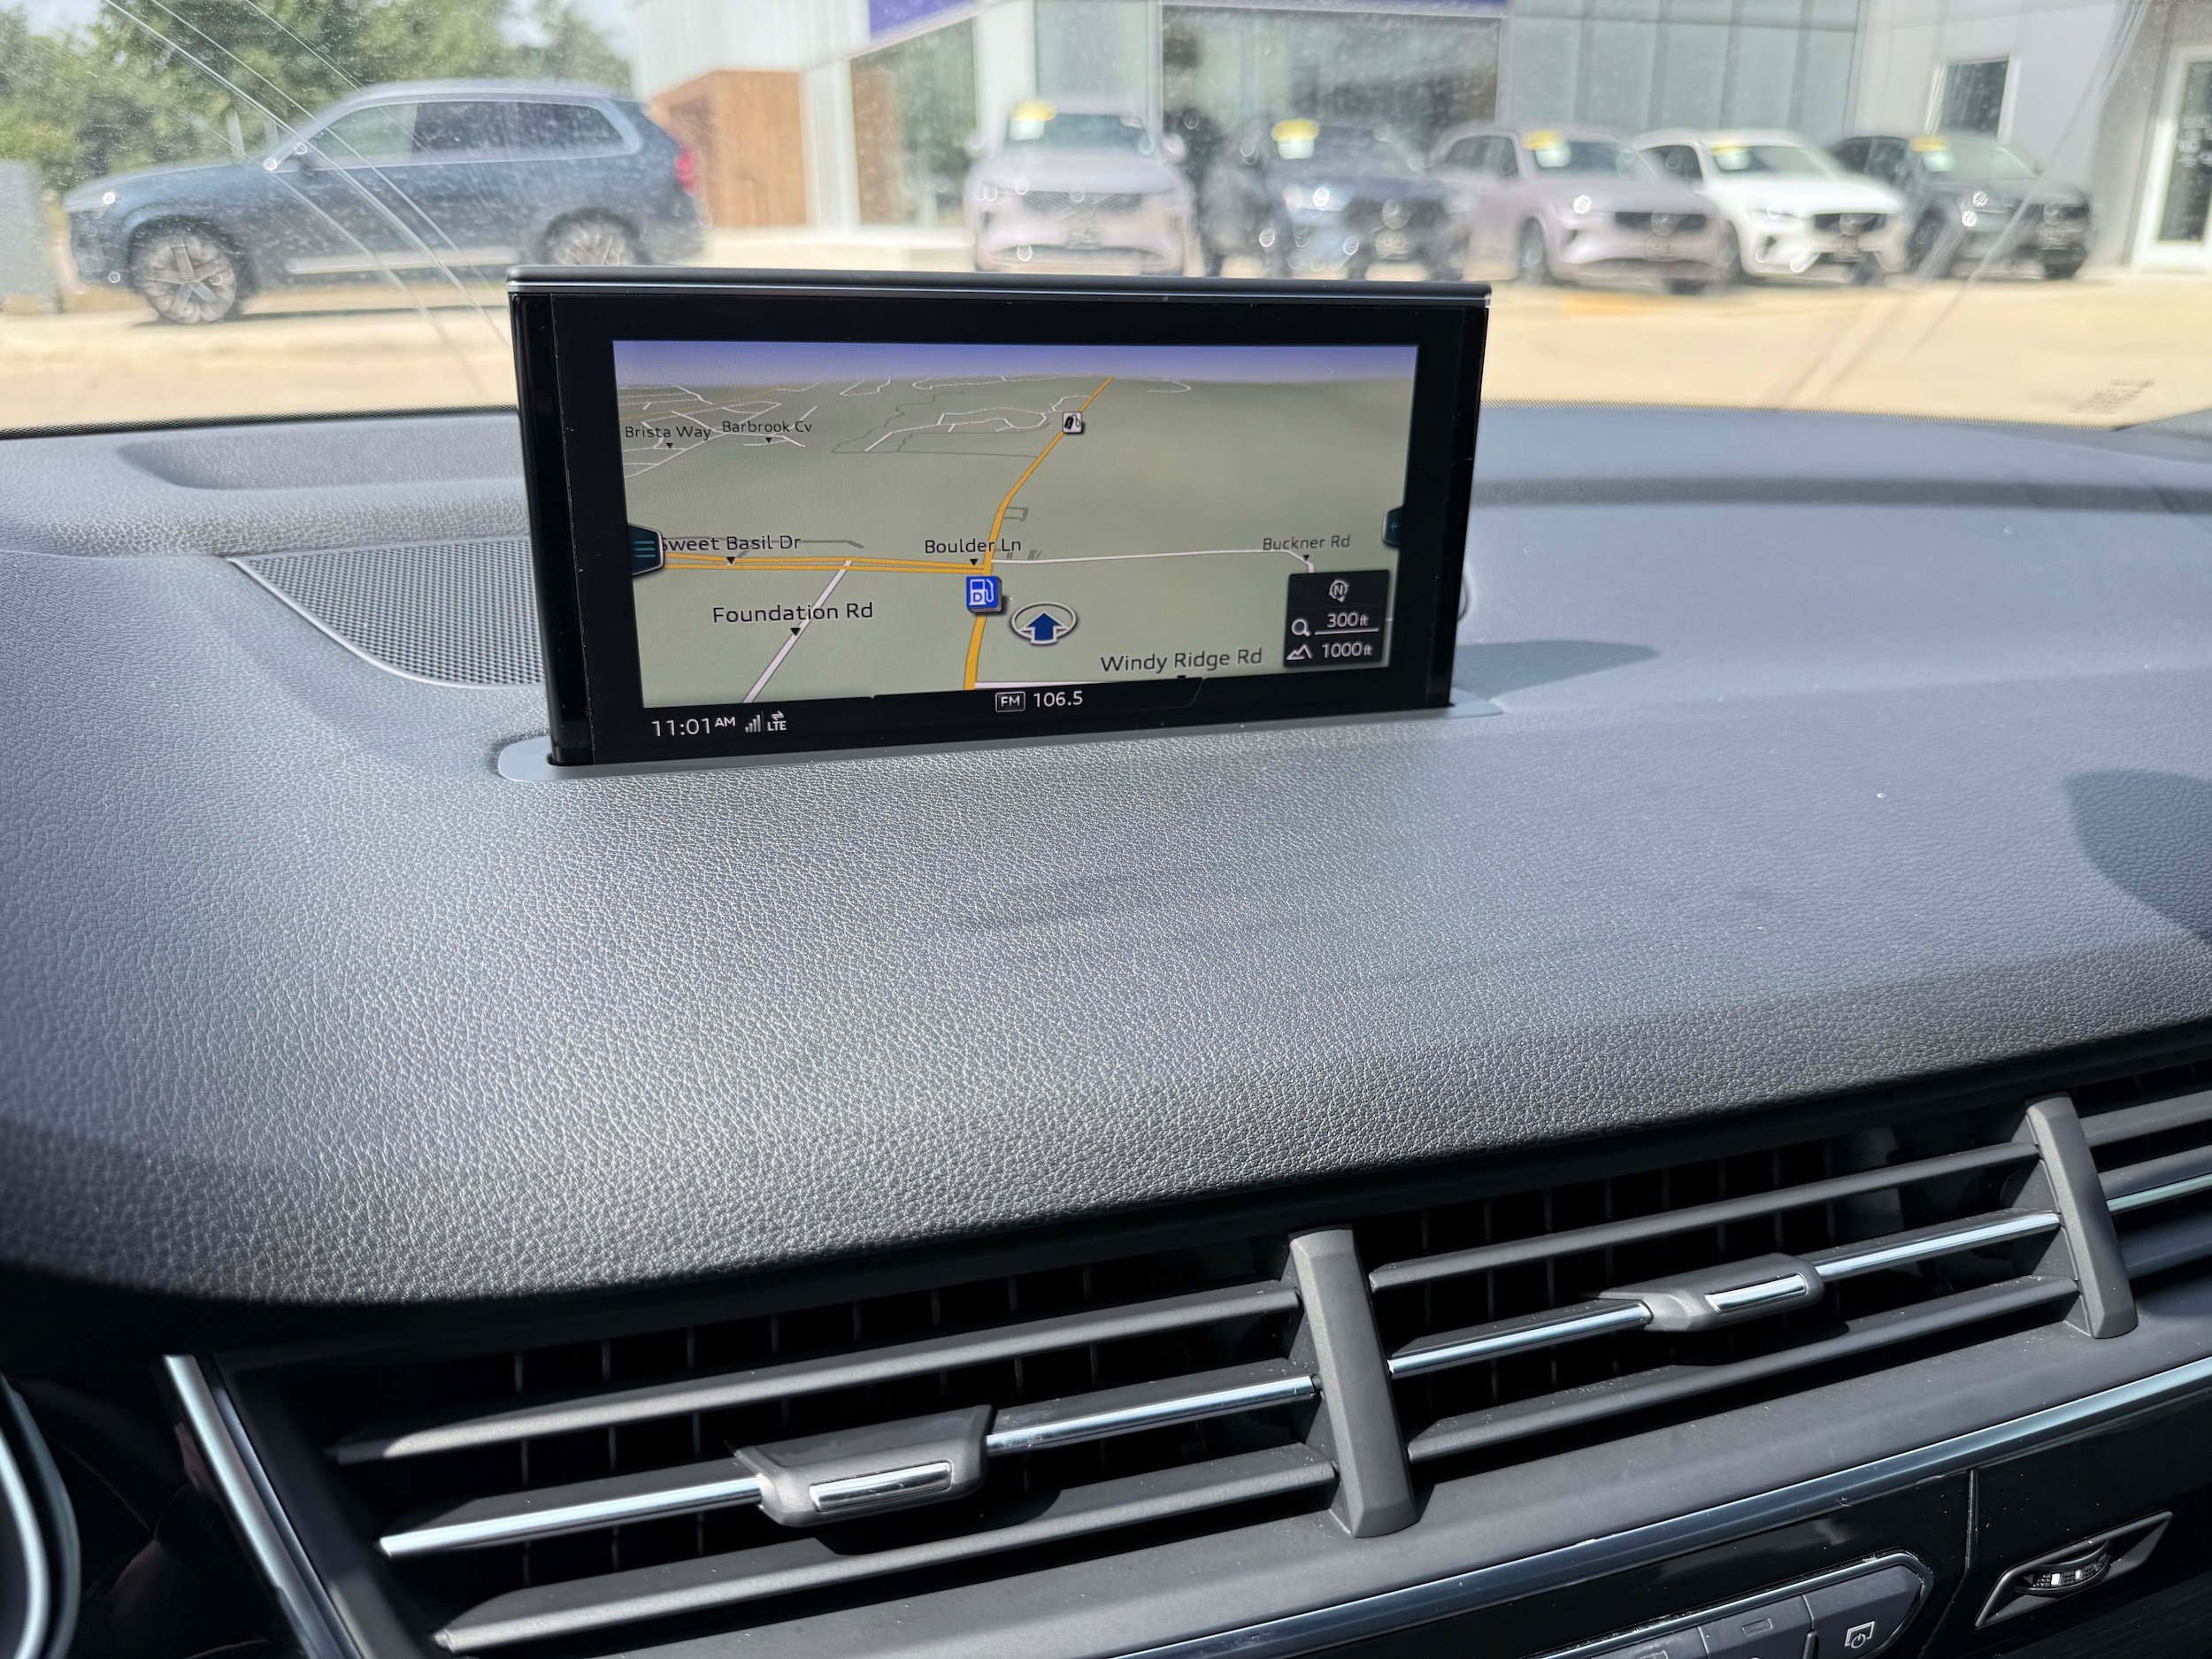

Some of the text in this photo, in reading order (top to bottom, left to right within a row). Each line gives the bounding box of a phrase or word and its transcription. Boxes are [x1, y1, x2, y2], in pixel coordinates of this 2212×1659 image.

[625, 426, 712, 441] Brista Way
[722, 420, 813, 433] Barbrook Cv
[726, 535, 773, 550] Basil
[780, 535, 802, 549] Dr
[925, 538, 1021, 554] Boulder Ln
[1263, 534, 1350, 550] Buckner Rd
[713, 602, 873, 624] Foundation Rd
[1100, 648, 1263, 674] Windy Ridge Rd
[1001, 690, 1083, 708] FM 106.5
[767, 720, 787, 731] LTE
